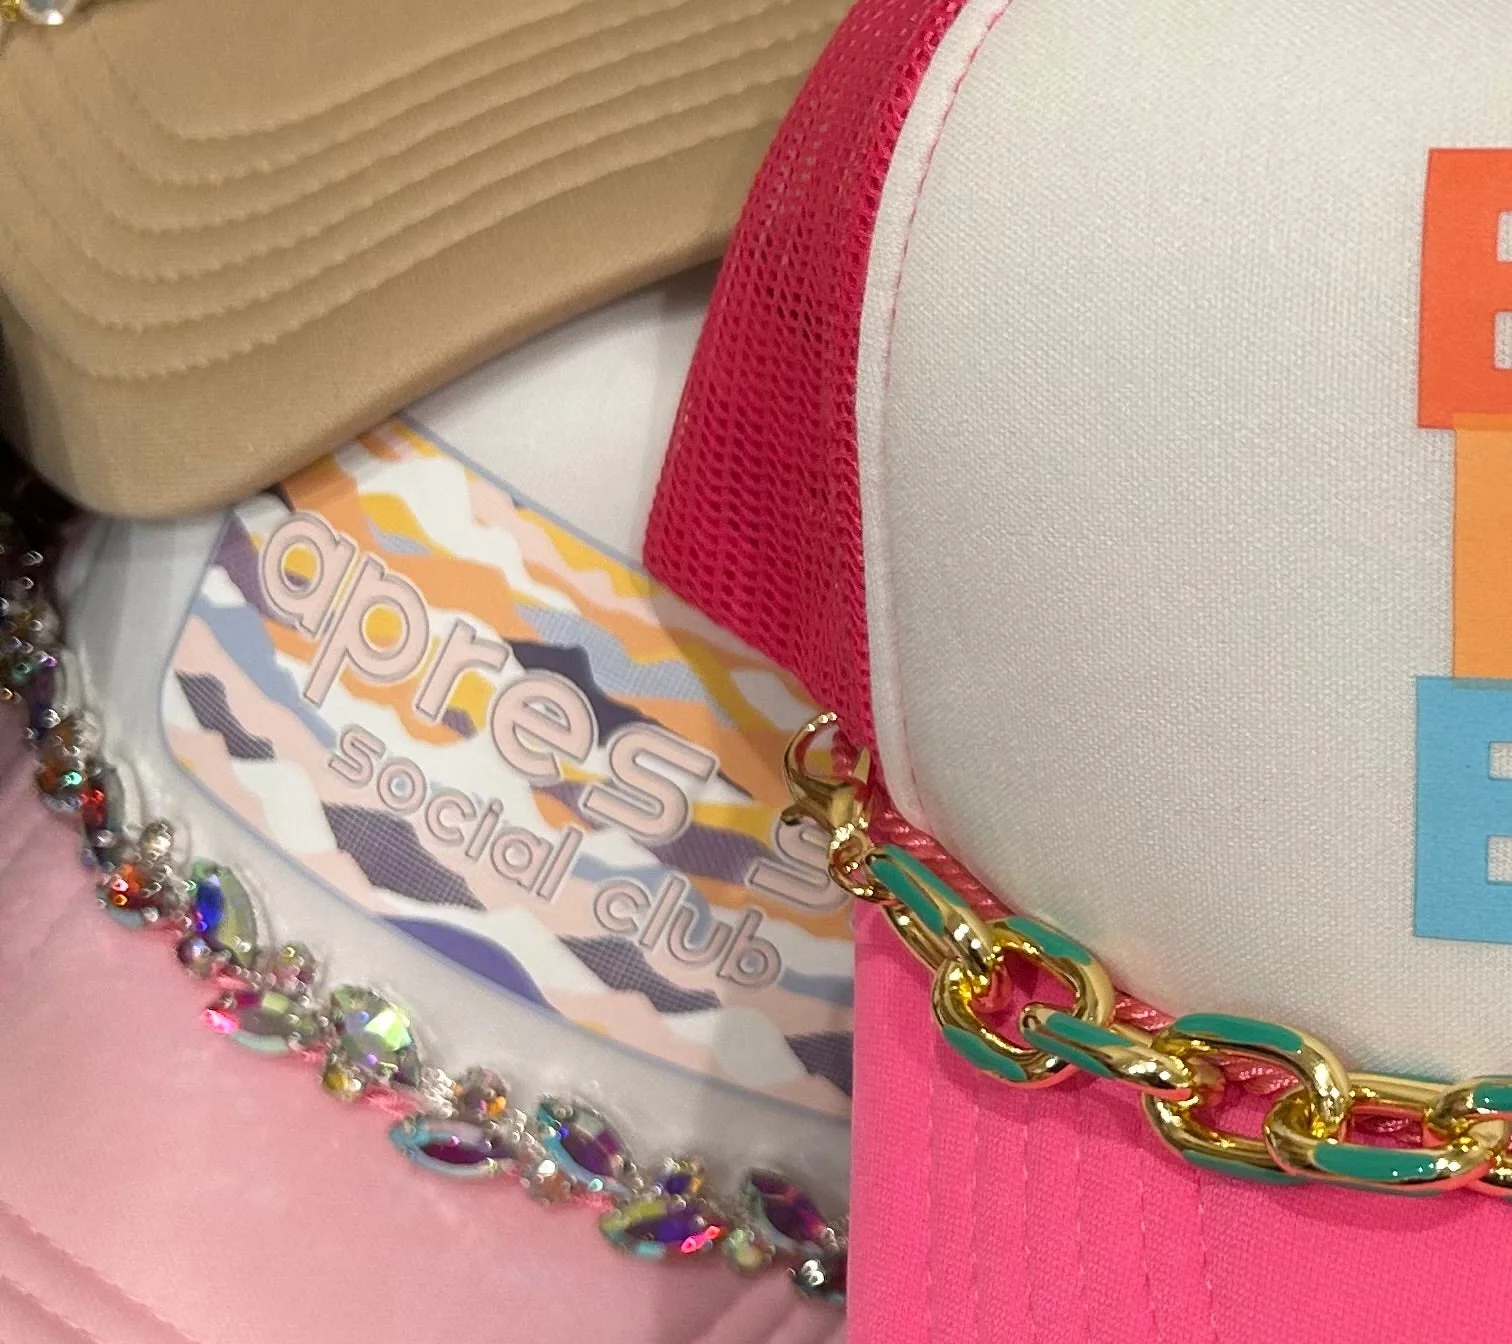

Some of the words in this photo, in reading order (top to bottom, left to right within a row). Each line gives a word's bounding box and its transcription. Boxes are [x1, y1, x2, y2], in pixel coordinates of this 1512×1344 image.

[256, 509, 720, 844] apres
[326, 722, 583, 903] social
[591, 874, 782, 990] club
